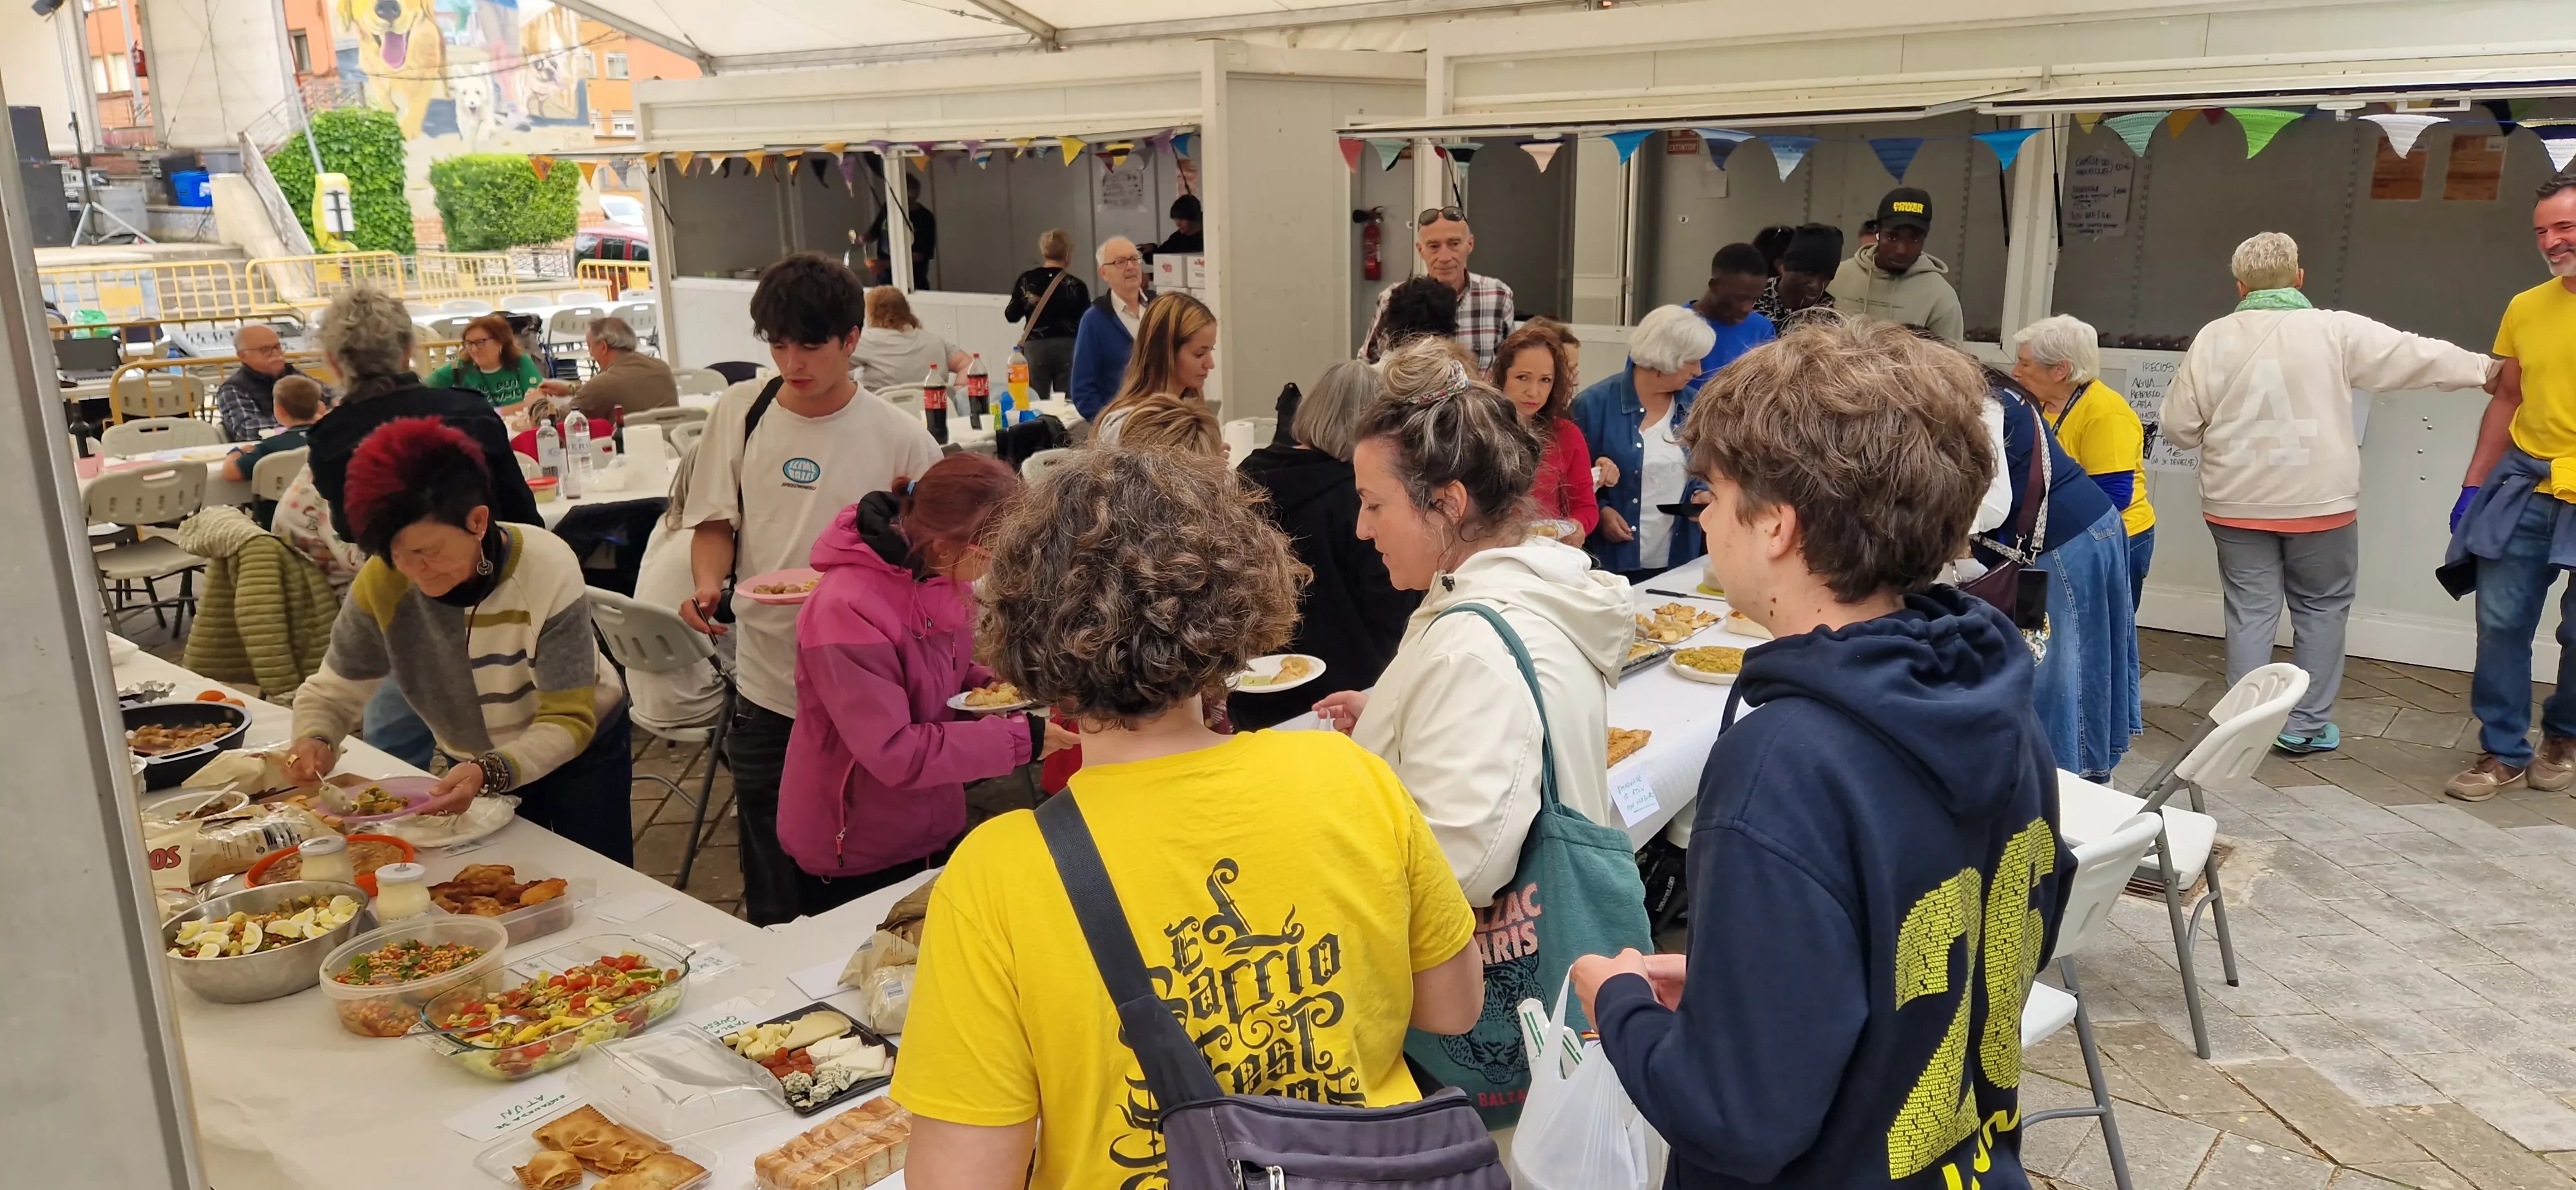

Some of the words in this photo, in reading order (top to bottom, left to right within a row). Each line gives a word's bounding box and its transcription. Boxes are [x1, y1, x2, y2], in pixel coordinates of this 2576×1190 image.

[1668, 143, 1697, 152] EXTINTOR
[1893, 202, 1924, 210] POWER
[2142, 361, 2175, 373] PRECIOS
[2132, 377, 2155, 388] AGUA
[2130, 390, 2161, 399] REFRESCO
[1475, 920, 1539, 965] ARIS
[1886, 817, 2056, 1180] 26
[1477, 1089, 1526, 1108] BALZA
